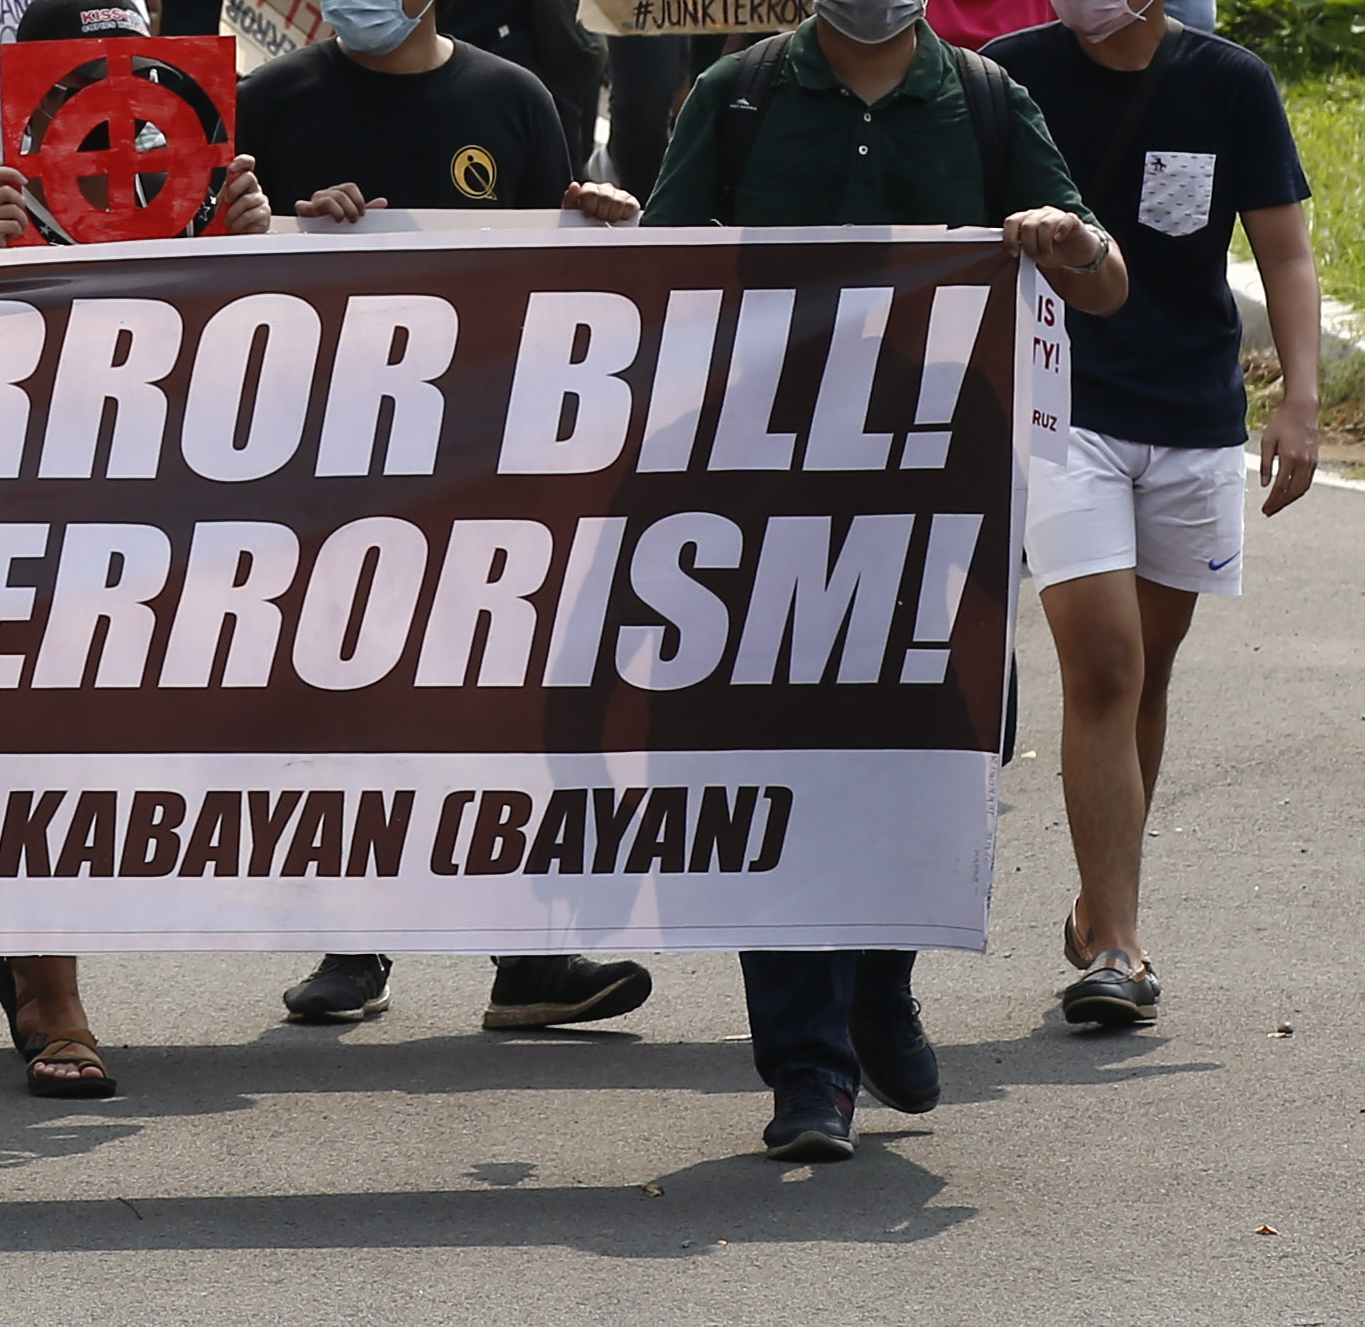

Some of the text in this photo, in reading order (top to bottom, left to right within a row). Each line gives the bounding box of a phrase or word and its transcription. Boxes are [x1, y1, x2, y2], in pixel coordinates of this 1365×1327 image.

[1036, 294, 1056, 328] IS
[497, 284, 992, 475] BILL!
[430, 784, 795, 879] (BAYAN)
